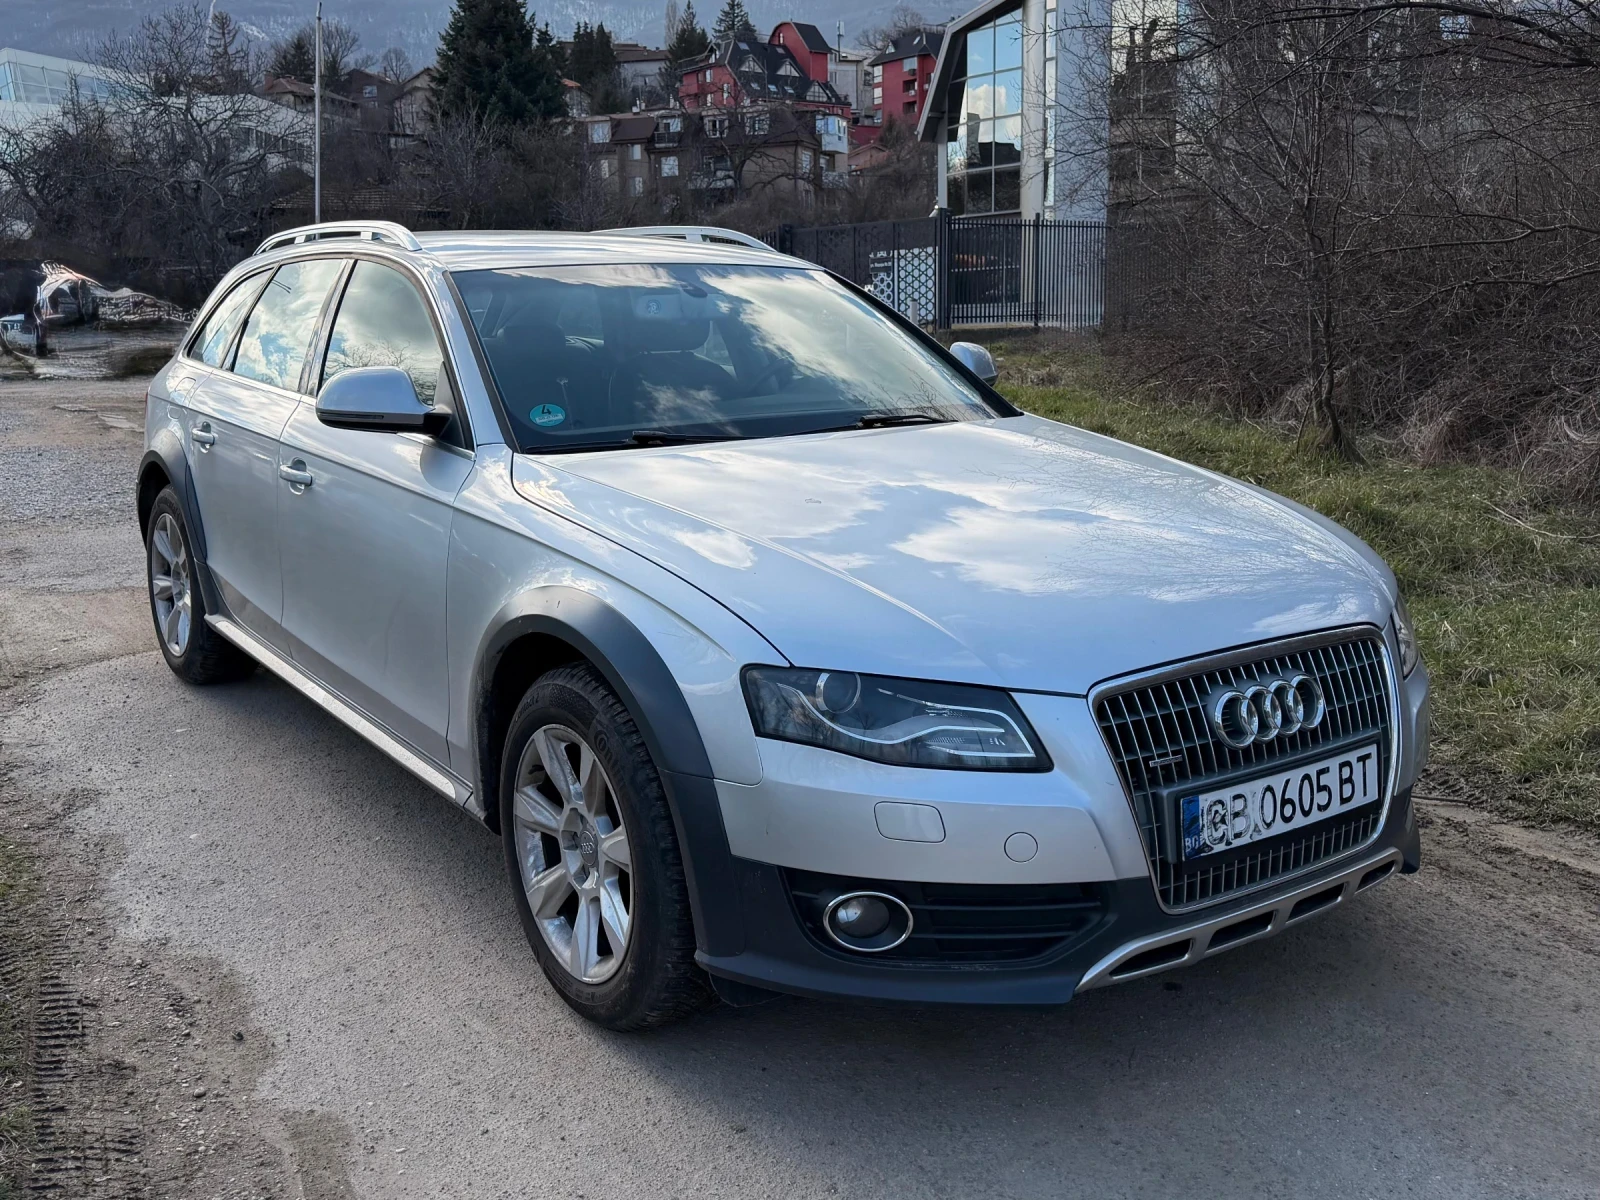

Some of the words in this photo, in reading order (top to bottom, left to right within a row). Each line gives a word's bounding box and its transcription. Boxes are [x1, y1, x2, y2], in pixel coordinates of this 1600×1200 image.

[541, 405, 552, 414] 4
[1261, 766, 1333, 829] 0605
[1338, 753, 1373, 806] BT
